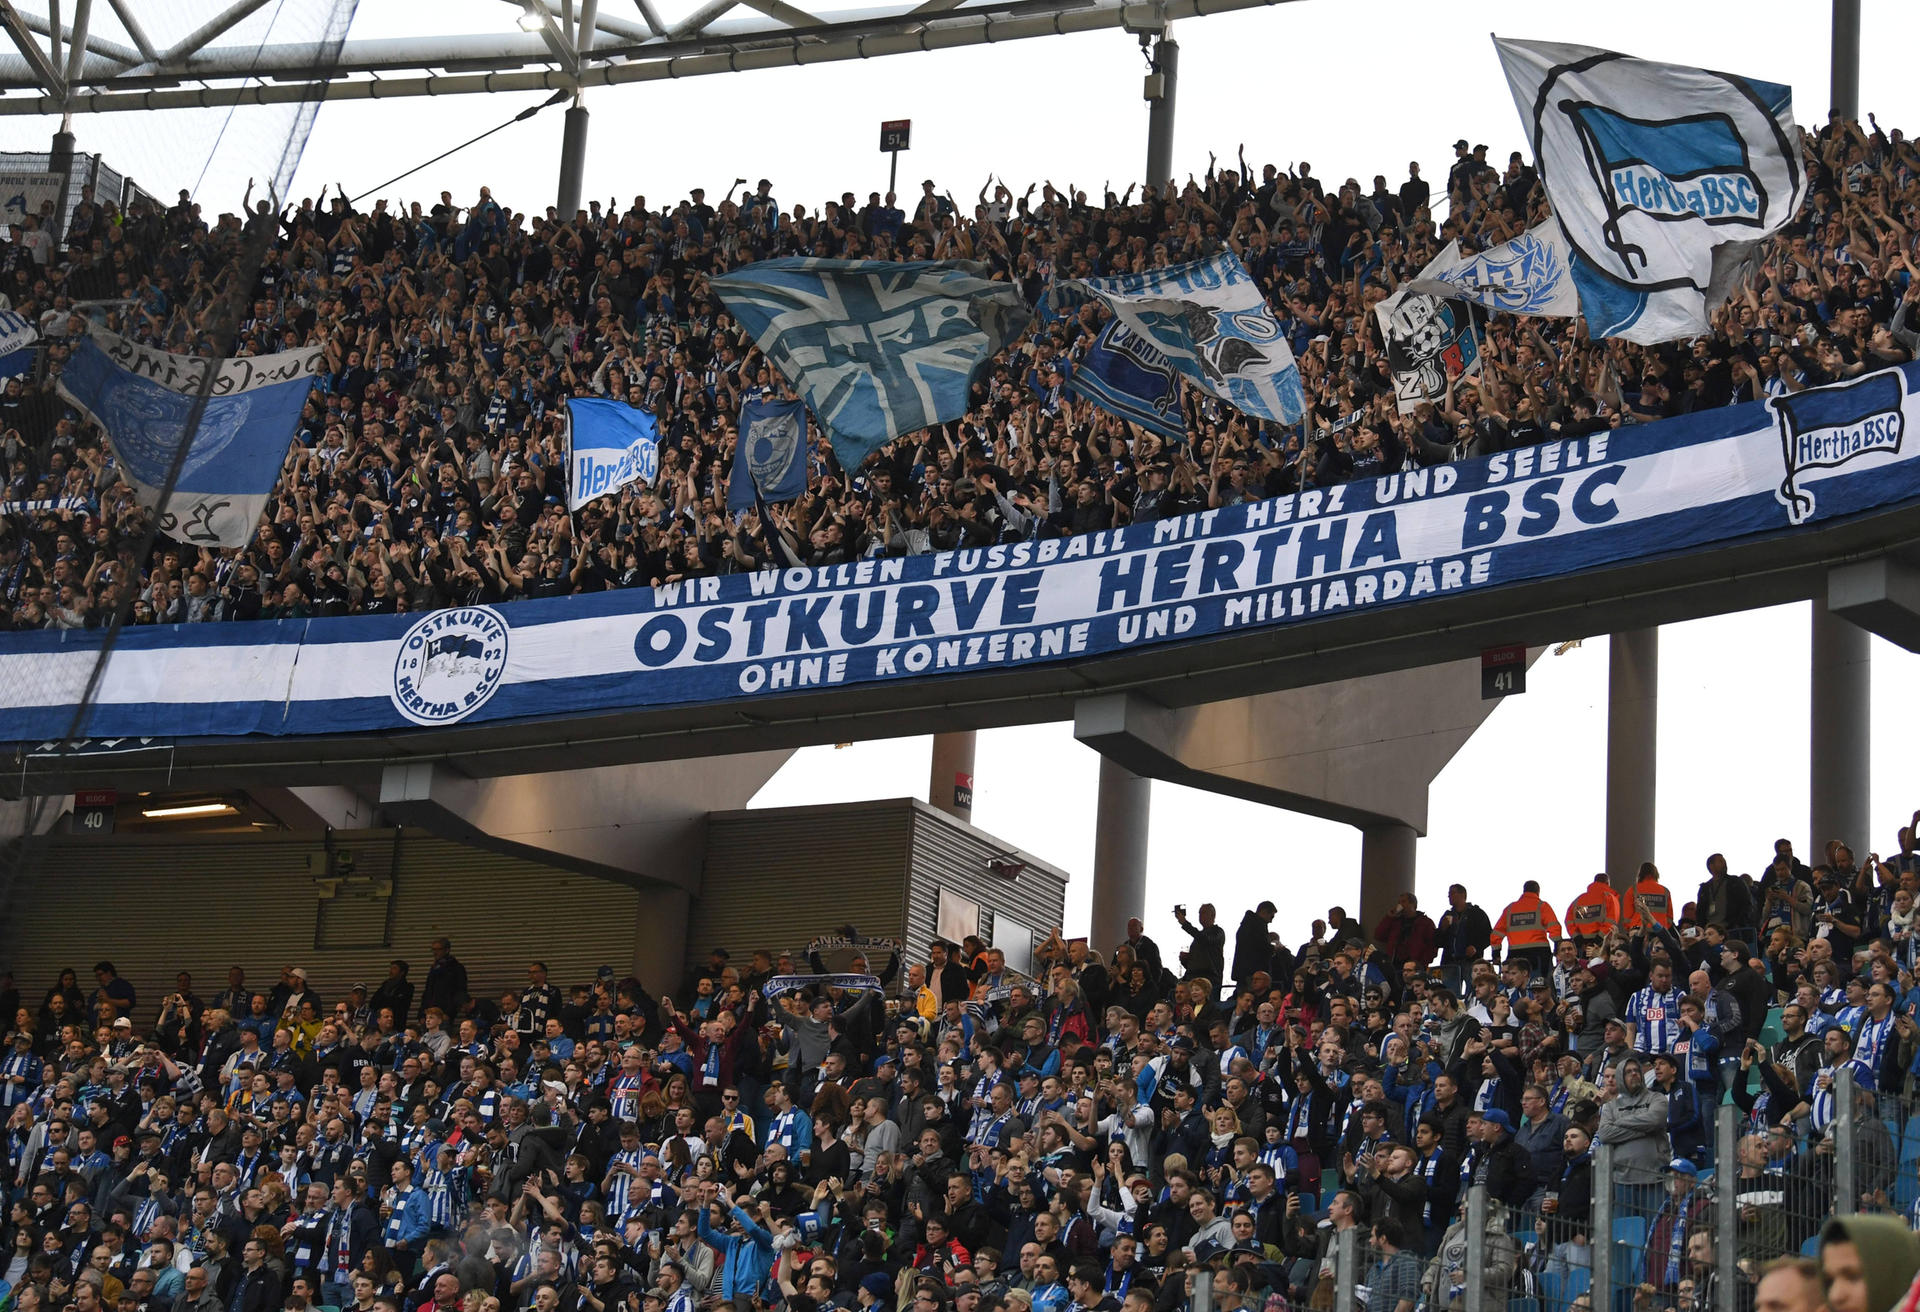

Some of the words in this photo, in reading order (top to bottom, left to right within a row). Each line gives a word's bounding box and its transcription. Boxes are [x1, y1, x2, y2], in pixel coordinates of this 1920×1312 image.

[888, 133, 901, 145] 51
[653, 576, 722, 608] WIR
[749, 558, 905, 597] WOLLEN
[934, 528, 1126, 576] FUSSBALL
[1153, 508, 1219, 543] MIT
[1245, 484, 1347, 529] HERZ
[1374, 465, 1458, 504] UND
[1486, 431, 1611, 484] SEELE
[634, 569, 1045, 668] OSTKURVE
[1096, 510, 1402, 613] HERTHA
[1461, 464, 1627, 550] BSC
[408, 611, 502, 651] OSTKURVE
[738, 653, 849, 693] OHNE
[875, 621, 1091, 677] KONZERNE
[1117, 605, 1198, 643] UND
[1224, 551, 1493, 627] MILLIARDÄRE
[399, 676, 460, 717] HERTHA
[463, 667, 499, 707] BSC
[1494, 671, 1512, 691] 41
[84, 811, 103, 829] 40
[1648, 1009, 1662, 1019] DB
[1676, 1041, 1689, 1051] DB
